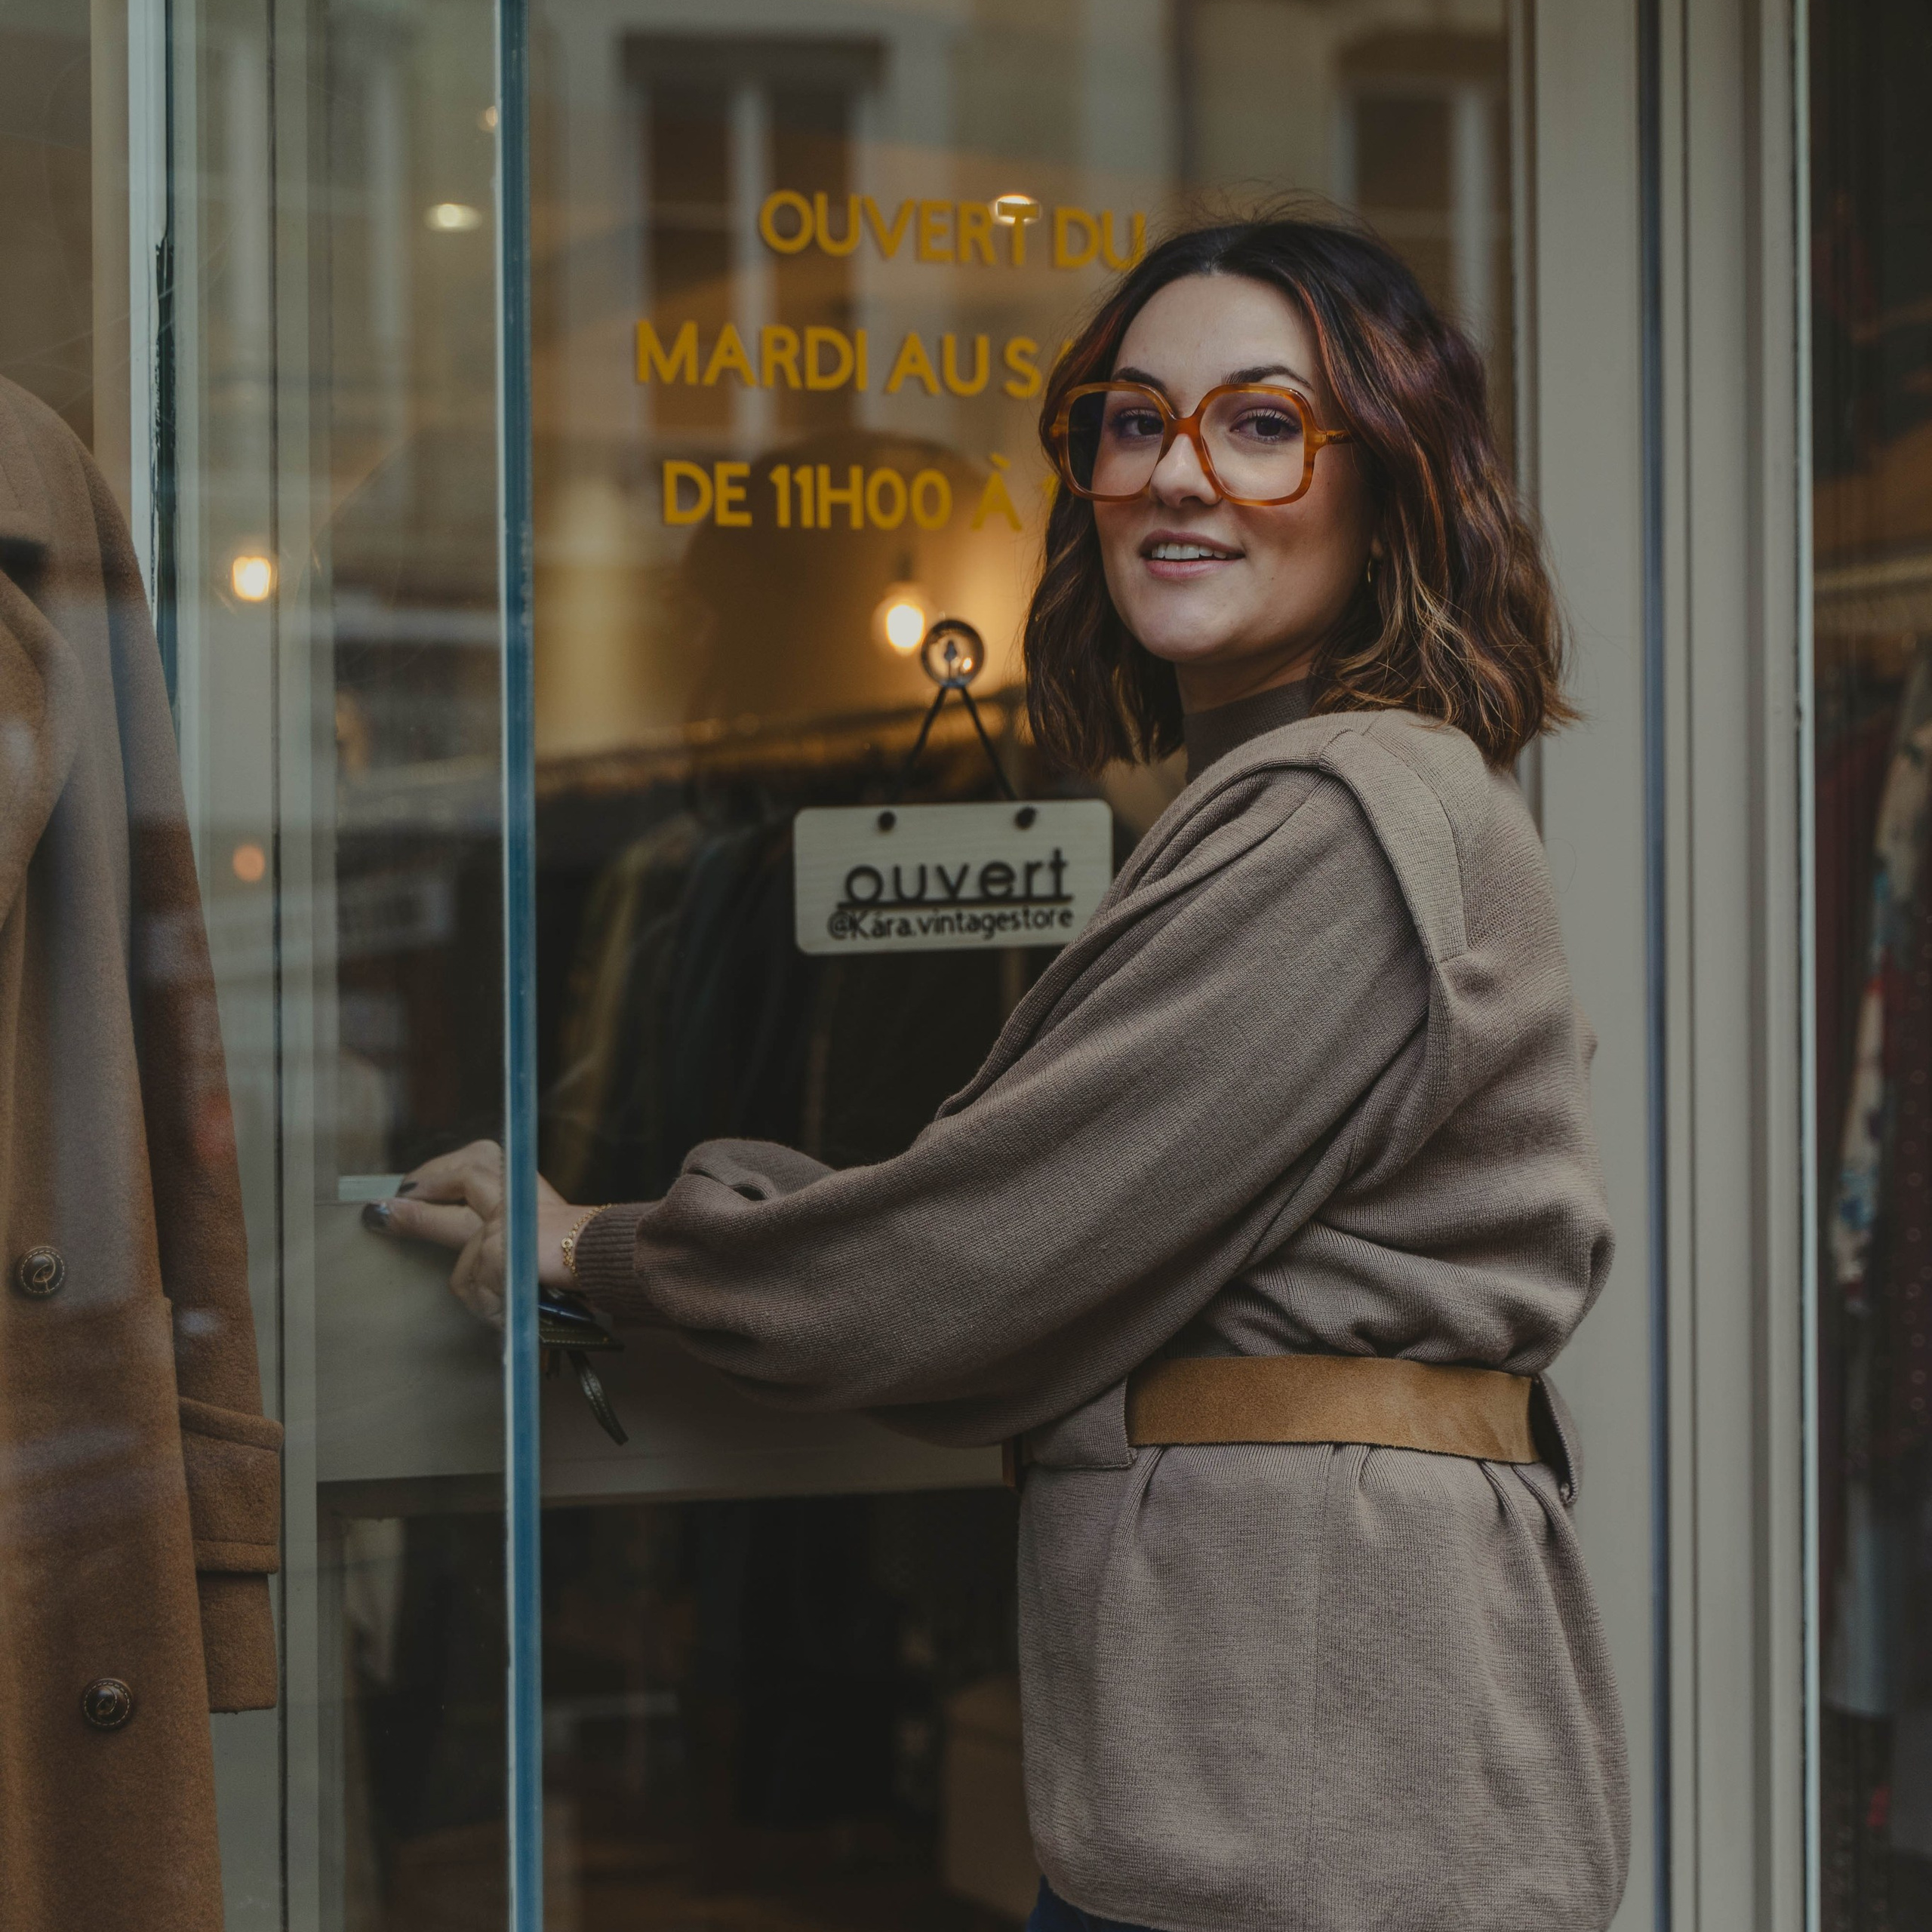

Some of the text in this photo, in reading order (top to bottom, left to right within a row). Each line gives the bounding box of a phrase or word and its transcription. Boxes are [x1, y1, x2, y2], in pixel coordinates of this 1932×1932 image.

[760, 190, 1146, 272] OUVERT DU
[635, 319, 1075, 399] MARDI AU S
[663, 460, 752, 527] DE
[768, 463, 953, 530] 11H00
[971, 452, 1022, 532] À
[844, 846, 1068, 903] ouvert
